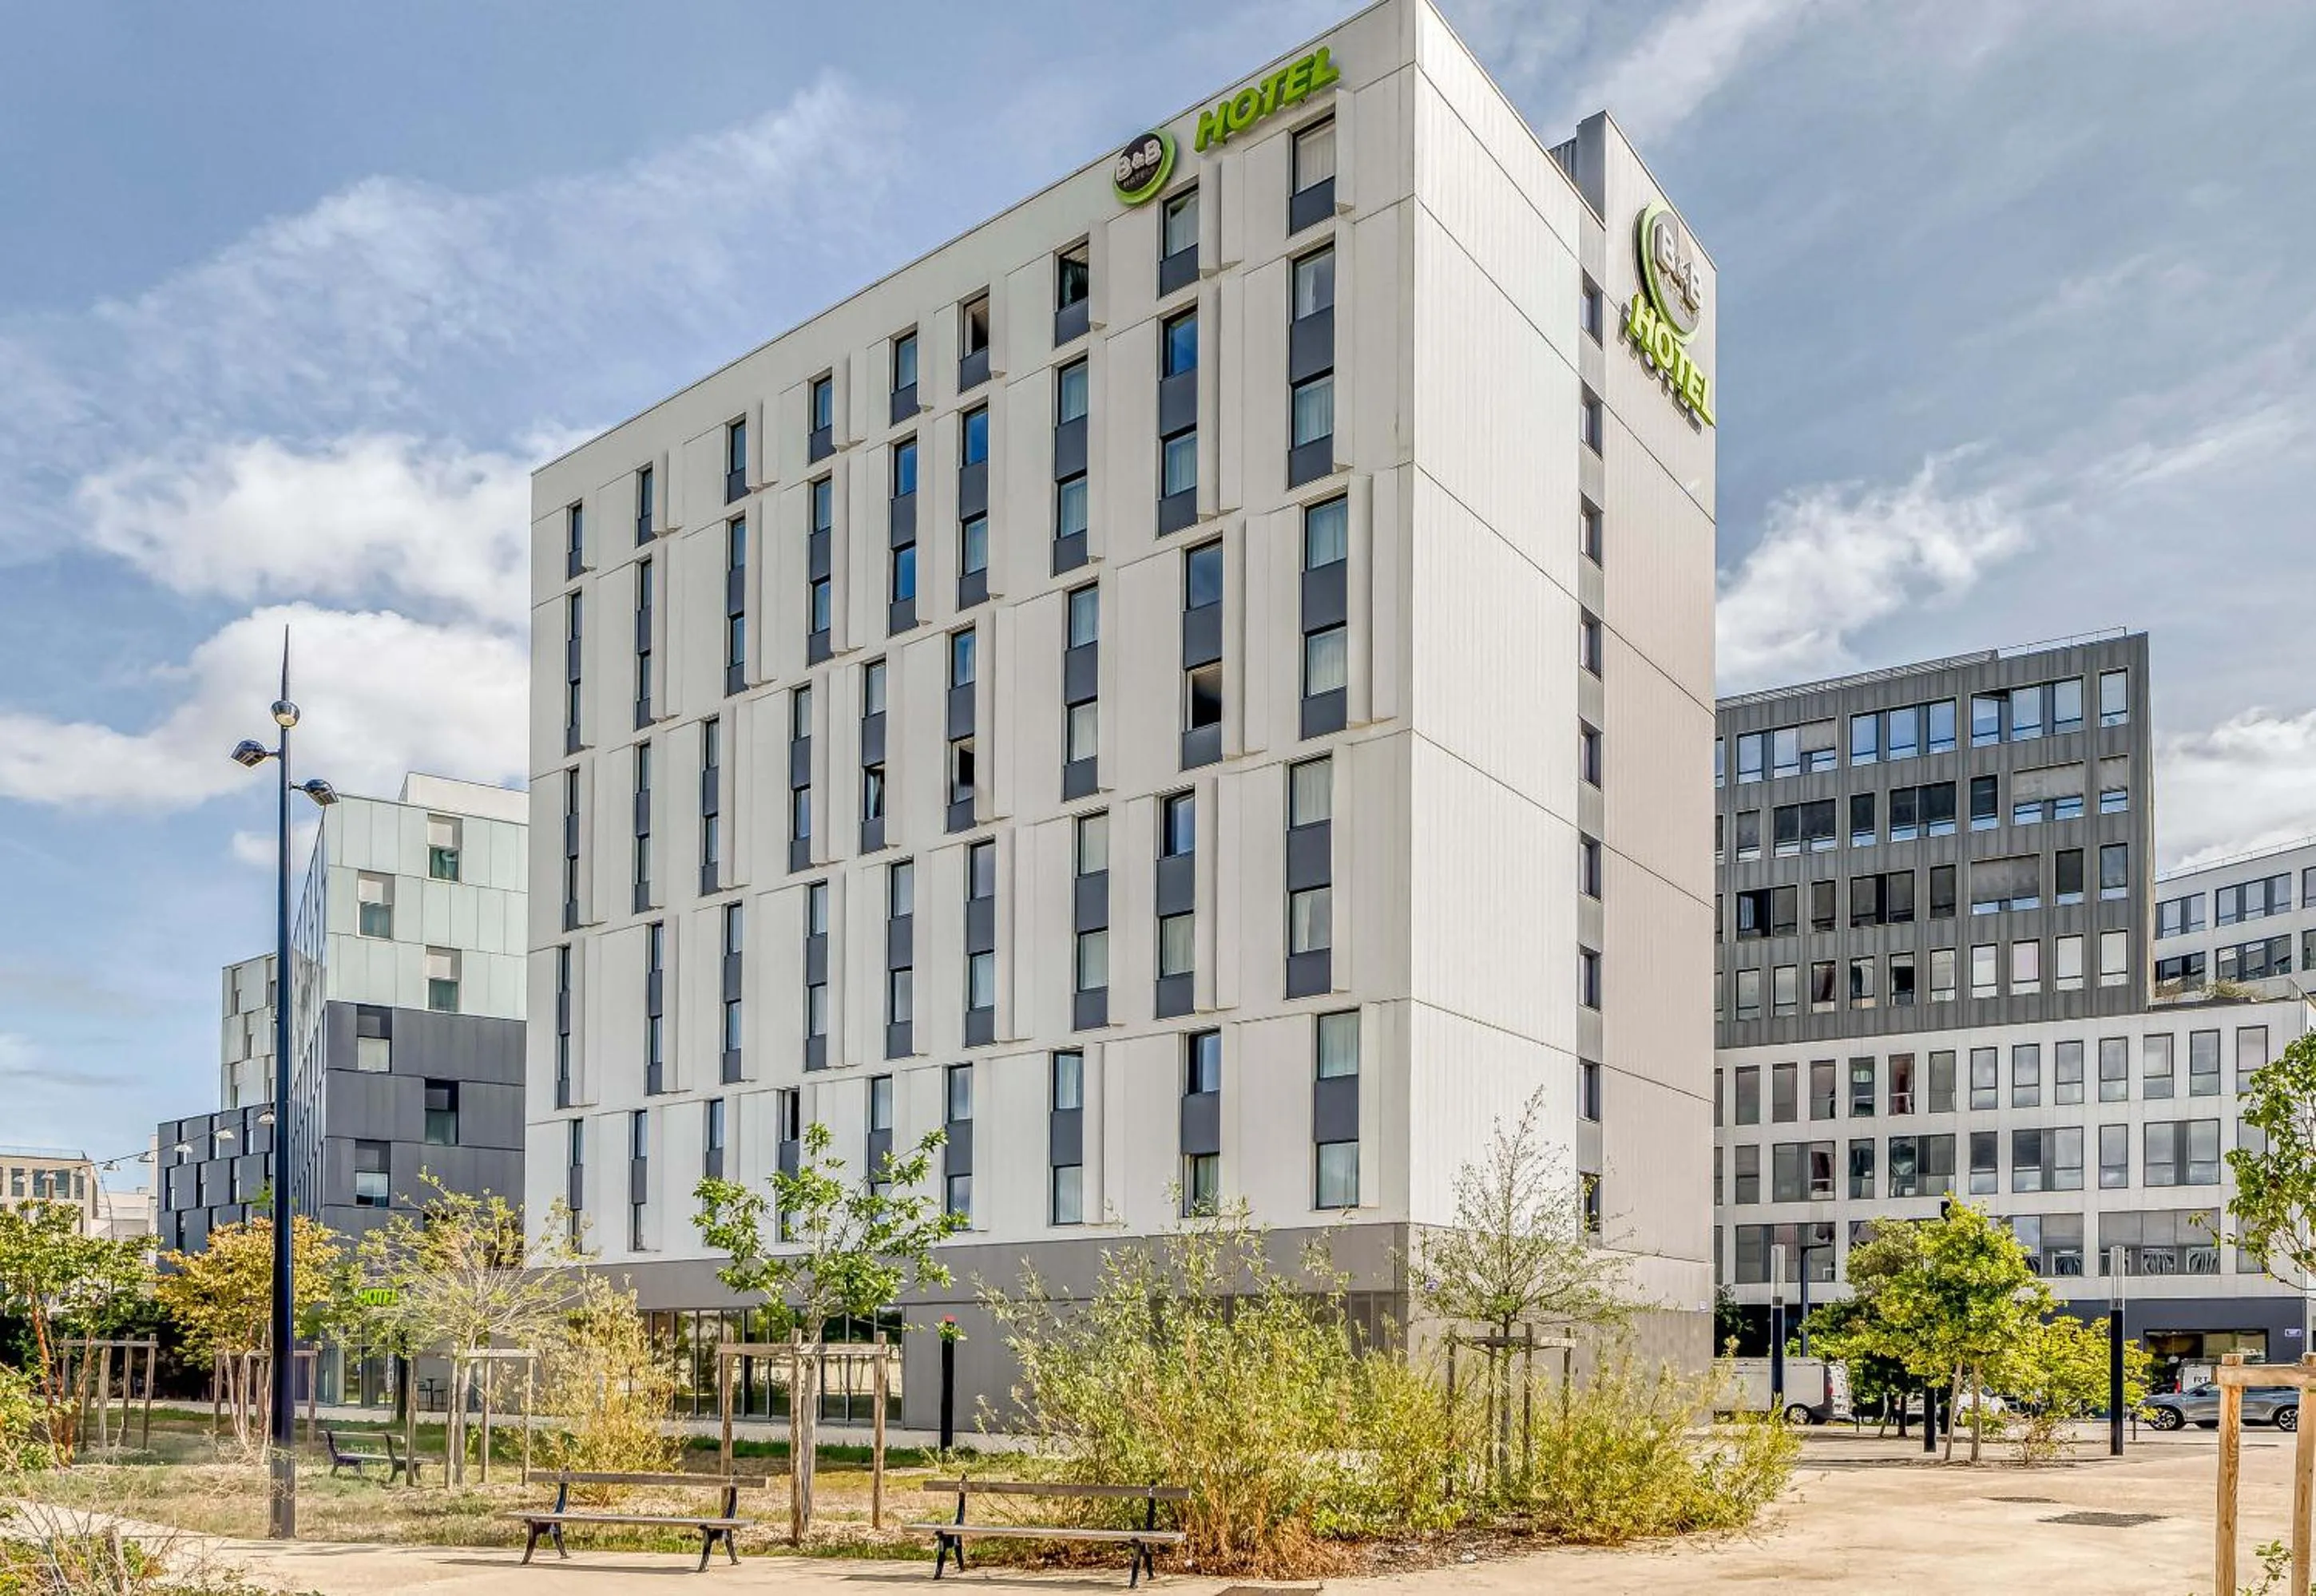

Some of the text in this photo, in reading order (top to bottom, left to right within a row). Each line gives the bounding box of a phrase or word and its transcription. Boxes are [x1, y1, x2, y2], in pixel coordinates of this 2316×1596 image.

[1194, 46, 1341, 153] HOTEL
[1116, 139, 1162, 182] B&B
[1656, 224, 1703, 310] B&B
[1629, 292, 1715, 427] HOTEL
